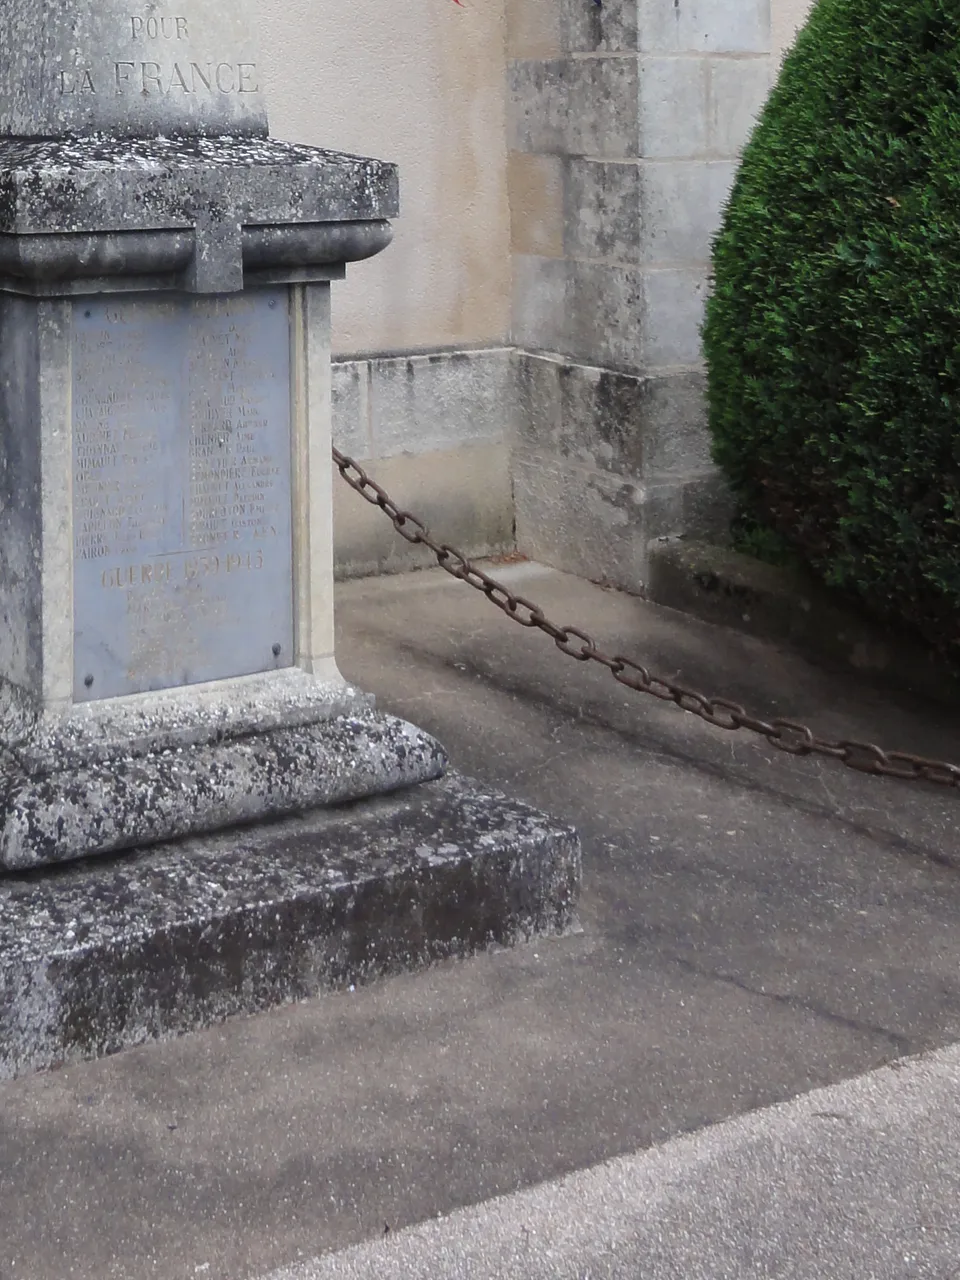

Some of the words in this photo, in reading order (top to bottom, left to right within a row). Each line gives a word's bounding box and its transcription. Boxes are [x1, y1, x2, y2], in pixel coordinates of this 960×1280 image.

[130, 16, 189, 40] POUR
[60, 70, 96, 95] LA
[113, 61, 259, 95] FRANCE
